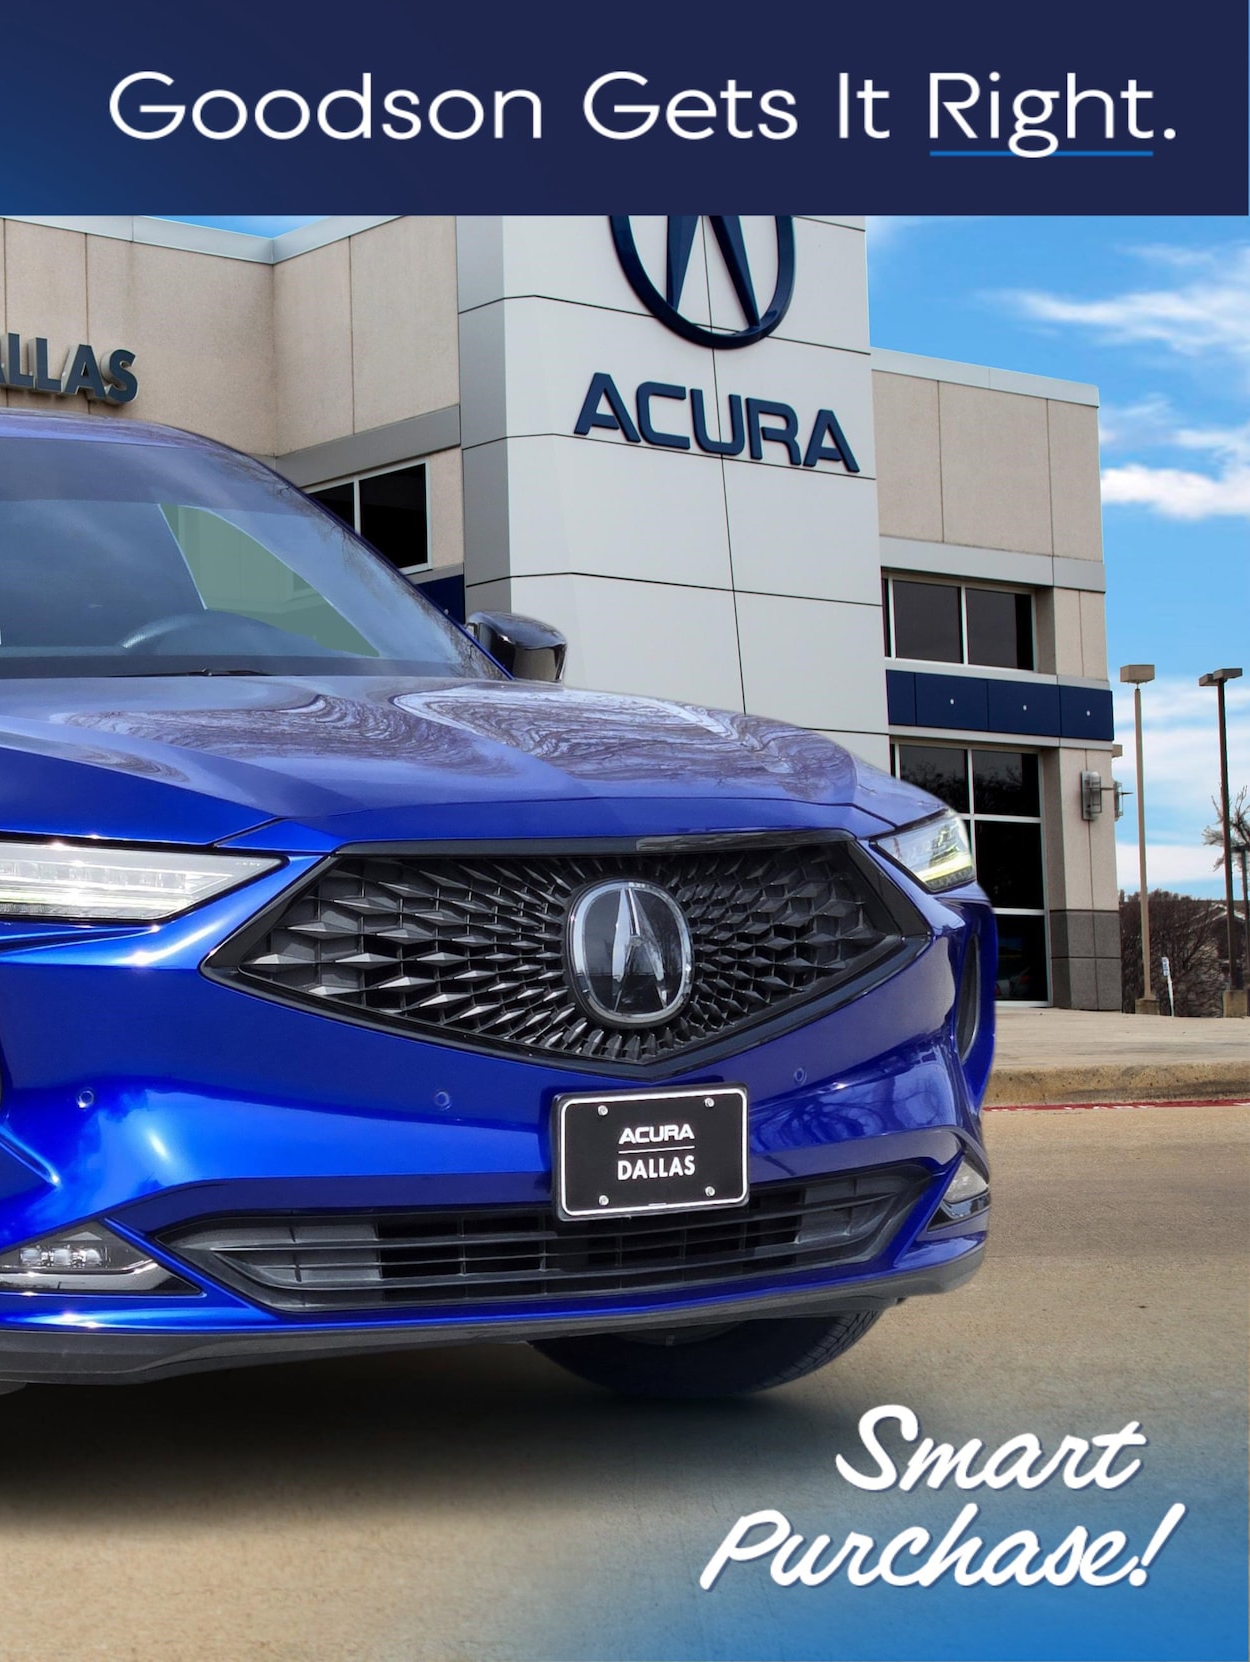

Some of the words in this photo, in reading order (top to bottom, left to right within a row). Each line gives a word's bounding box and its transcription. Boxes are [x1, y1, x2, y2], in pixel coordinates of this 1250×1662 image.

[574, 372, 860, 473] ACURA
[618, 1124, 695, 1144] ACURA
[617, 1155, 695, 1180] DALLAS
